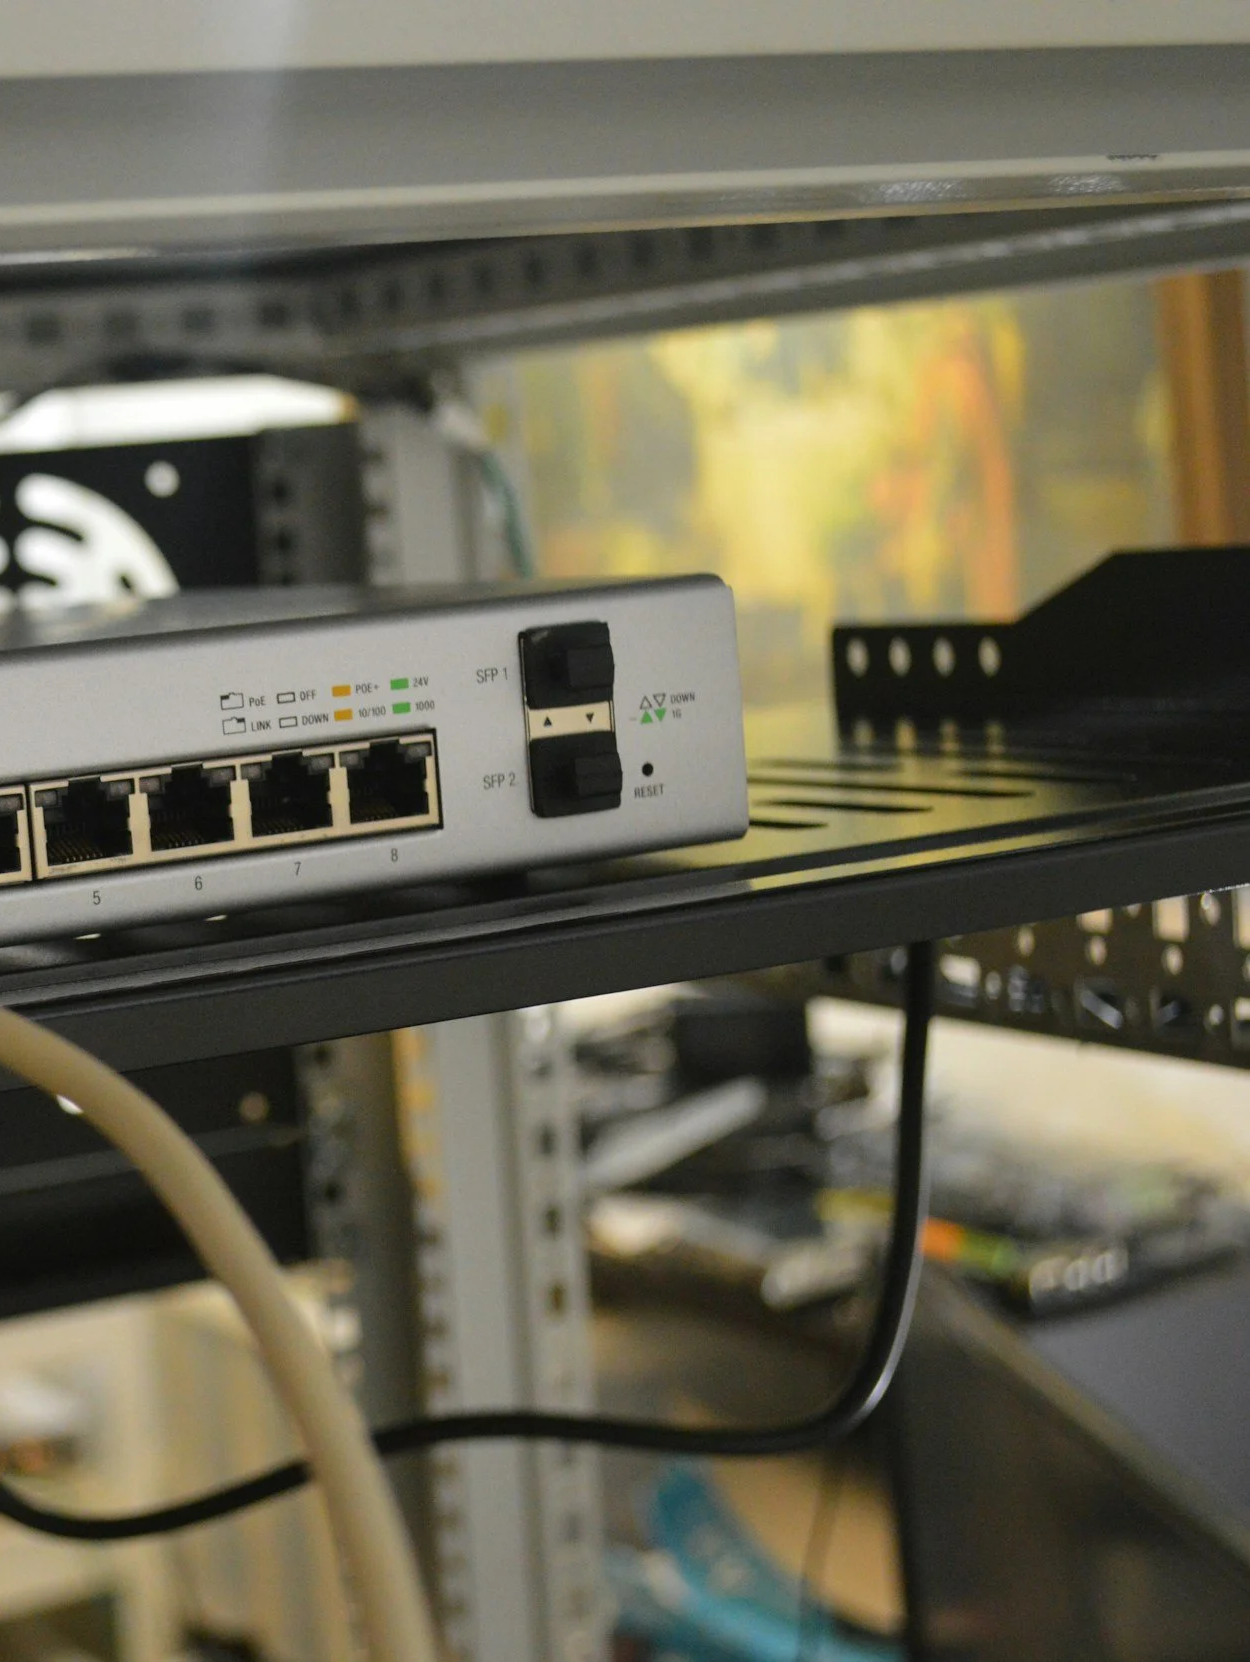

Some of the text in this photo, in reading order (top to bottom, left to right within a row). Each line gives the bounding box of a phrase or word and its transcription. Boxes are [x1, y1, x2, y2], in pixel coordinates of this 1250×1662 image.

[476, 667, 508, 684] SFP 1
[412, 677, 430, 688] 24V
[249, 696, 266, 708] PoE
[299, 690, 317, 702] OFF
[670, 693, 696, 705] DOWN
[358, 706, 387, 718] 10/100
[415, 701, 436, 712] 1000
[302, 713, 330, 725] DOWN
[671, 708, 682, 719] 1G
[251, 721, 272, 732] LINK
[483, 772, 517, 790] SFP 2
[634, 784, 665, 798] RESET
[391, 848, 400, 863] 8
[294, 862, 303, 876] 7
[193, 876, 203, 891] 6
[92, 890, 102, 906] 5
